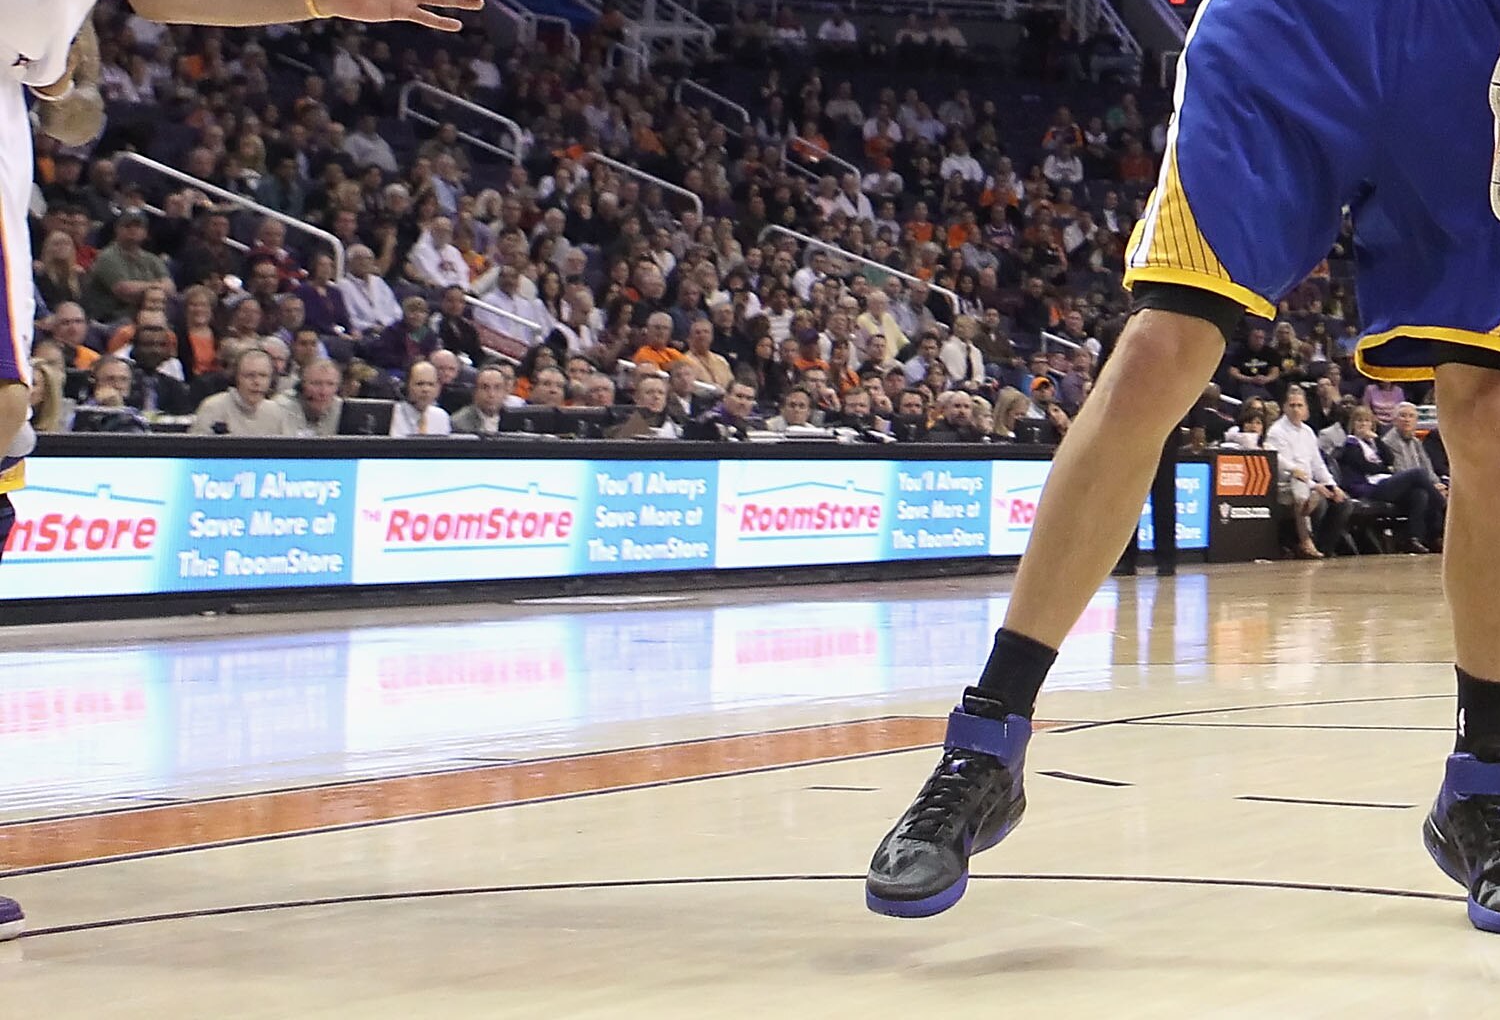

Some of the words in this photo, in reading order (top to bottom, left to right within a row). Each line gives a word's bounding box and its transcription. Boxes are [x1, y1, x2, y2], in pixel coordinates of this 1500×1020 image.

[191, 471, 257, 500] You'll
[259, 471, 342, 505] Always
[597, 471, 645, 496] You'll
[647, 471, 707, 501] Always
[898, 470, 936, 493] You'll
[937, 470, 984, 496] Always
[189, 510, 246, 537] Save
[249, 510, 309, 536] More
[312, 513, 337, 535] at
[595, 506, 637, 529] Save
[639, 505, 683, 527] More
[685, 507, 703, 526] at
[739, 502, 881, 532] RoomStore
[897, 500, 930, 520] Save
[932, 500, 963, 519] More
[965, 500, 980, 519] at
[385, 508, 573, 543] RoomStore
[892, 529, 915, 550] The
[917, 528, 985, 550] RoomStore
[178, 549, 219, 578] The
[224, 547, 344, 577] RoomStore
[588, 539, 619, 563] The
[621, 537, 710, 561] RoomStore
